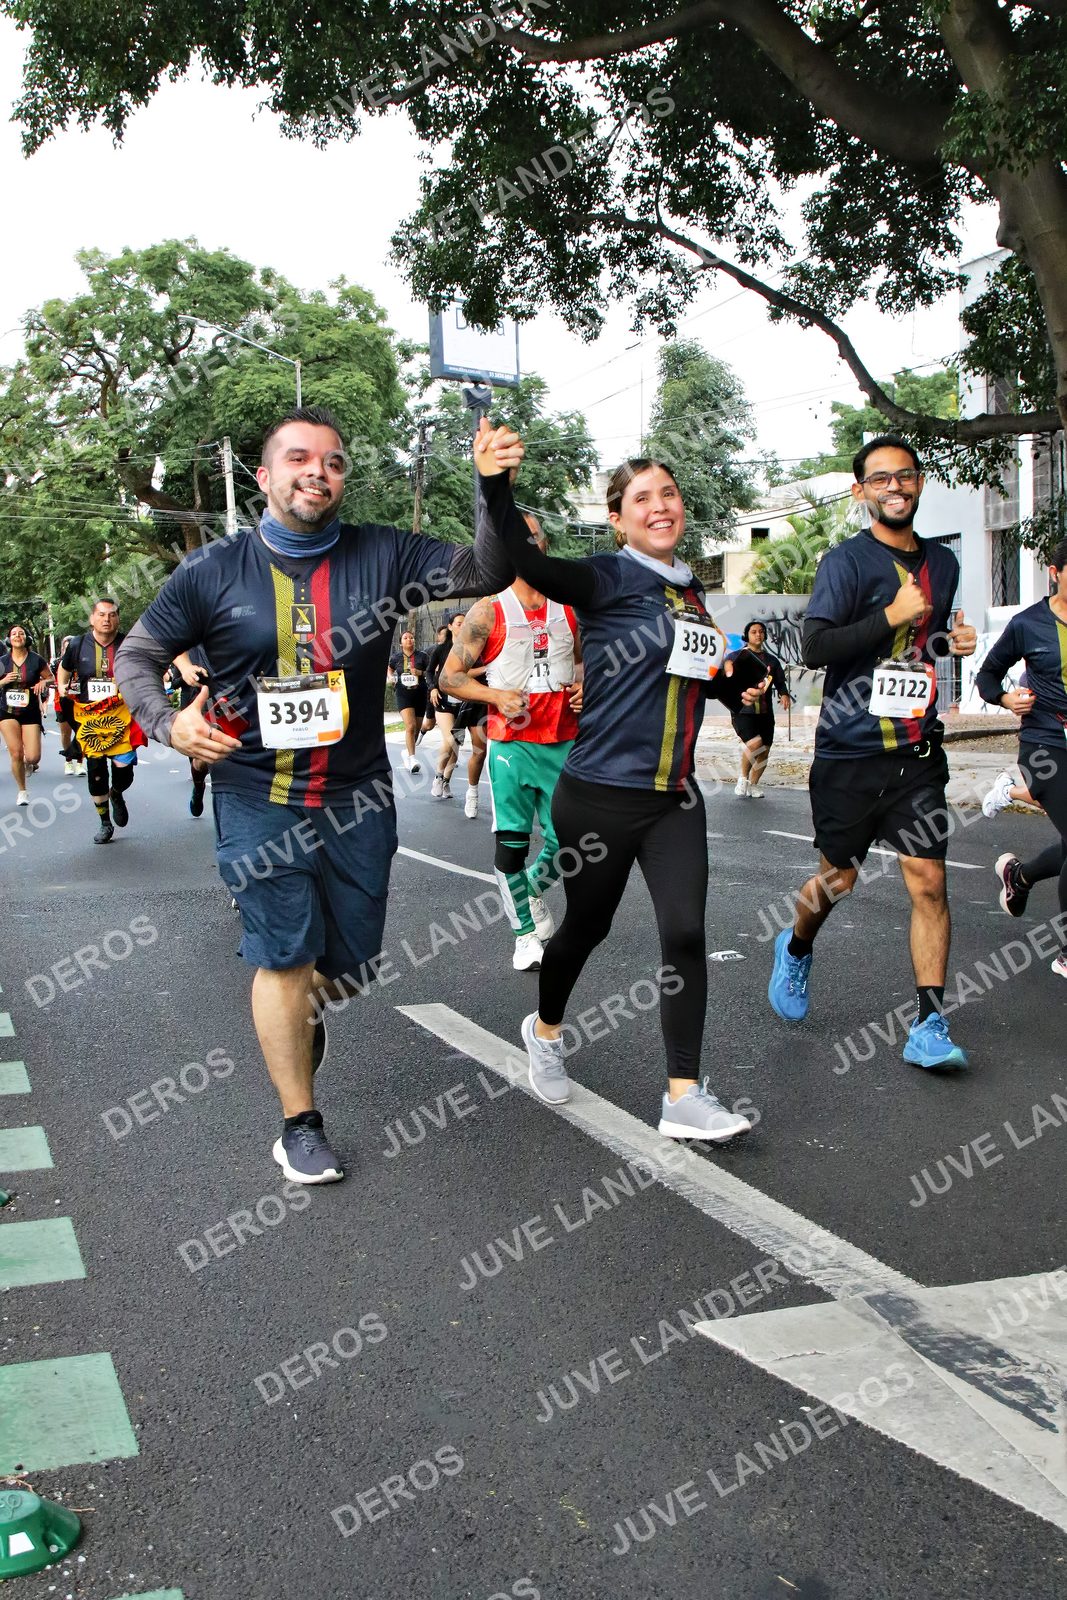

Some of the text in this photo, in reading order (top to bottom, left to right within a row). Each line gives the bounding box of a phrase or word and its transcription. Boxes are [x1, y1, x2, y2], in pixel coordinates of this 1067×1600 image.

[682, 629, 717, 656] 3395
[92, 685, 111, 693] 3341
[330, 677, 341, 686] 5K
[878, 677, 928, 698] 12122
[269, 698, 329, 725] 3394
